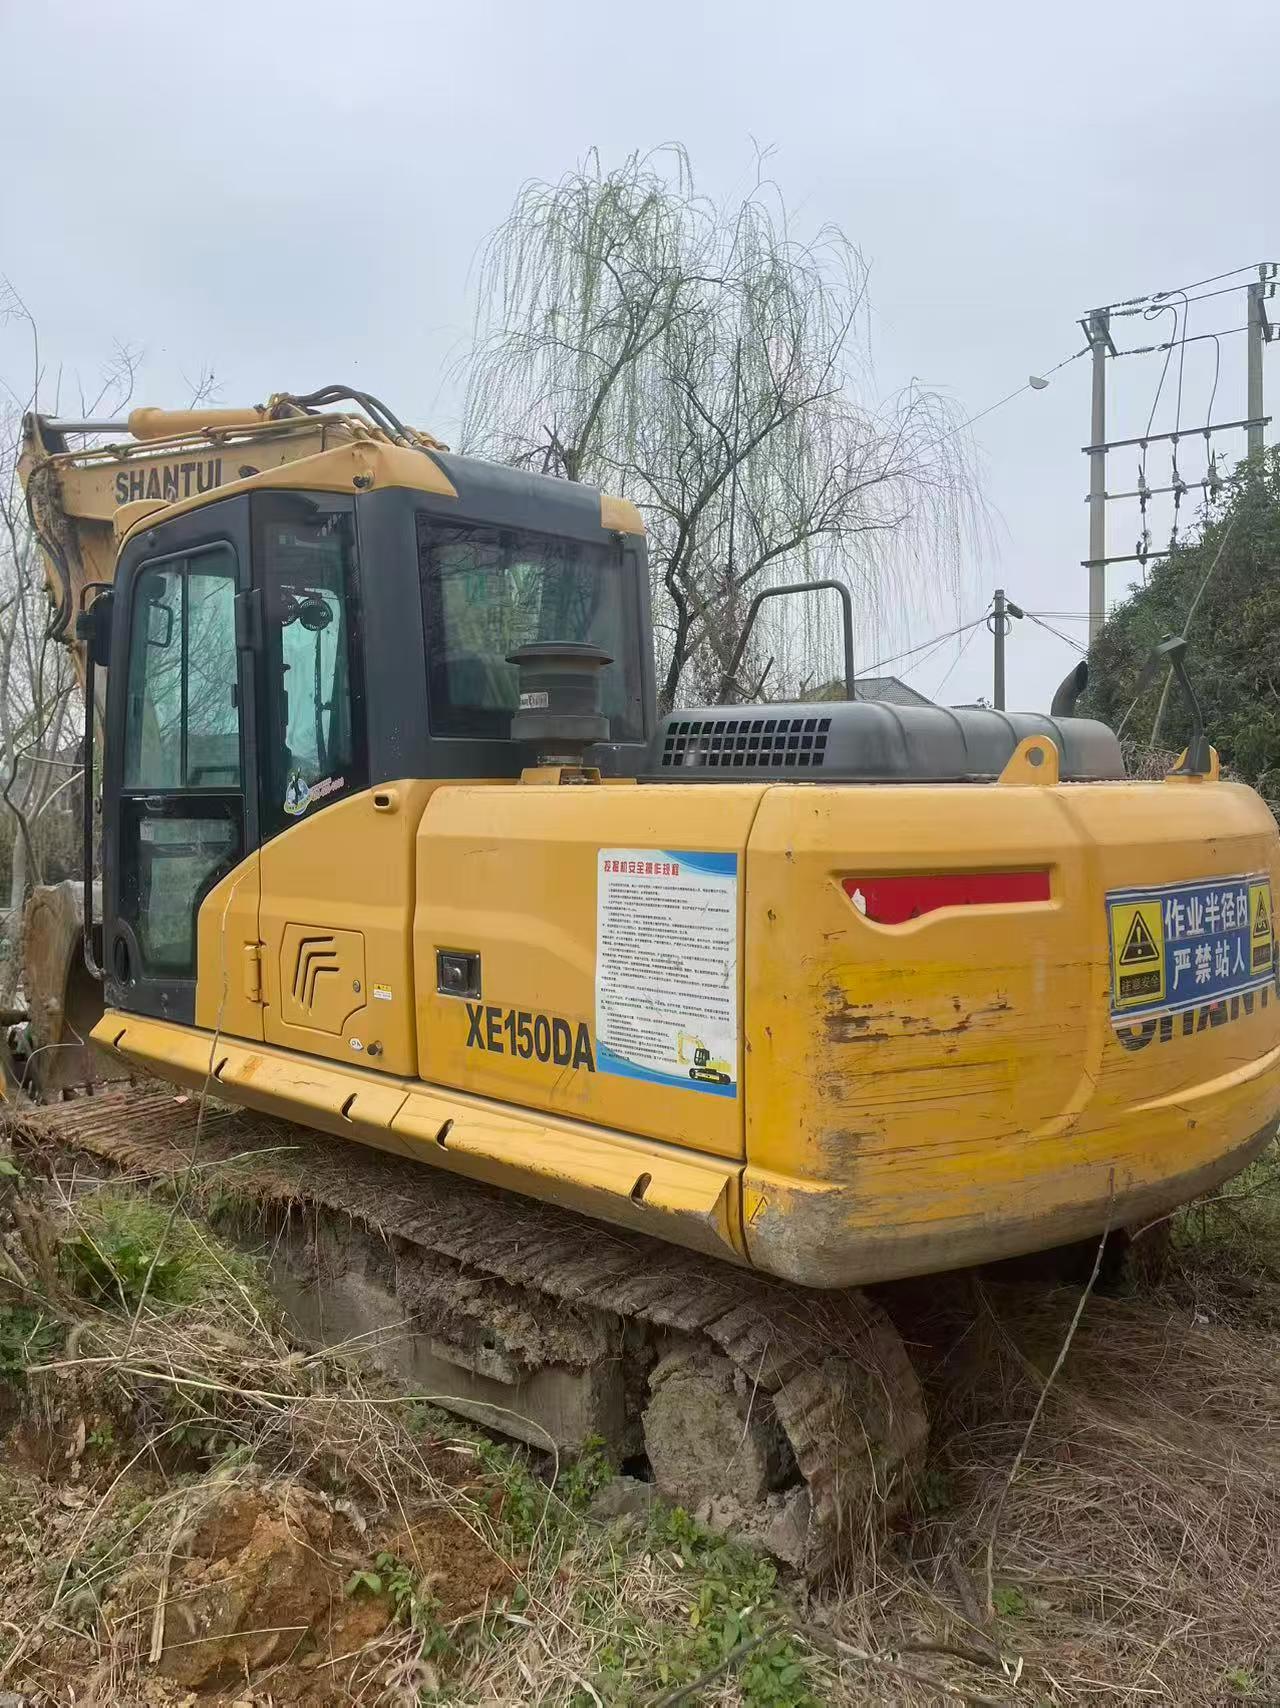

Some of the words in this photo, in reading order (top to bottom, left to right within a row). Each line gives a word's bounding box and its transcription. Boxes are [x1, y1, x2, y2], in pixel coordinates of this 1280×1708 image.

[115, 459, 222, 505] SHANTUI
[1165, 889, 1248, 940] 作业半径内
[1172, 937, 1246, 990] 严禁站人
[466, 1003, 596, 1073] XE150DA
